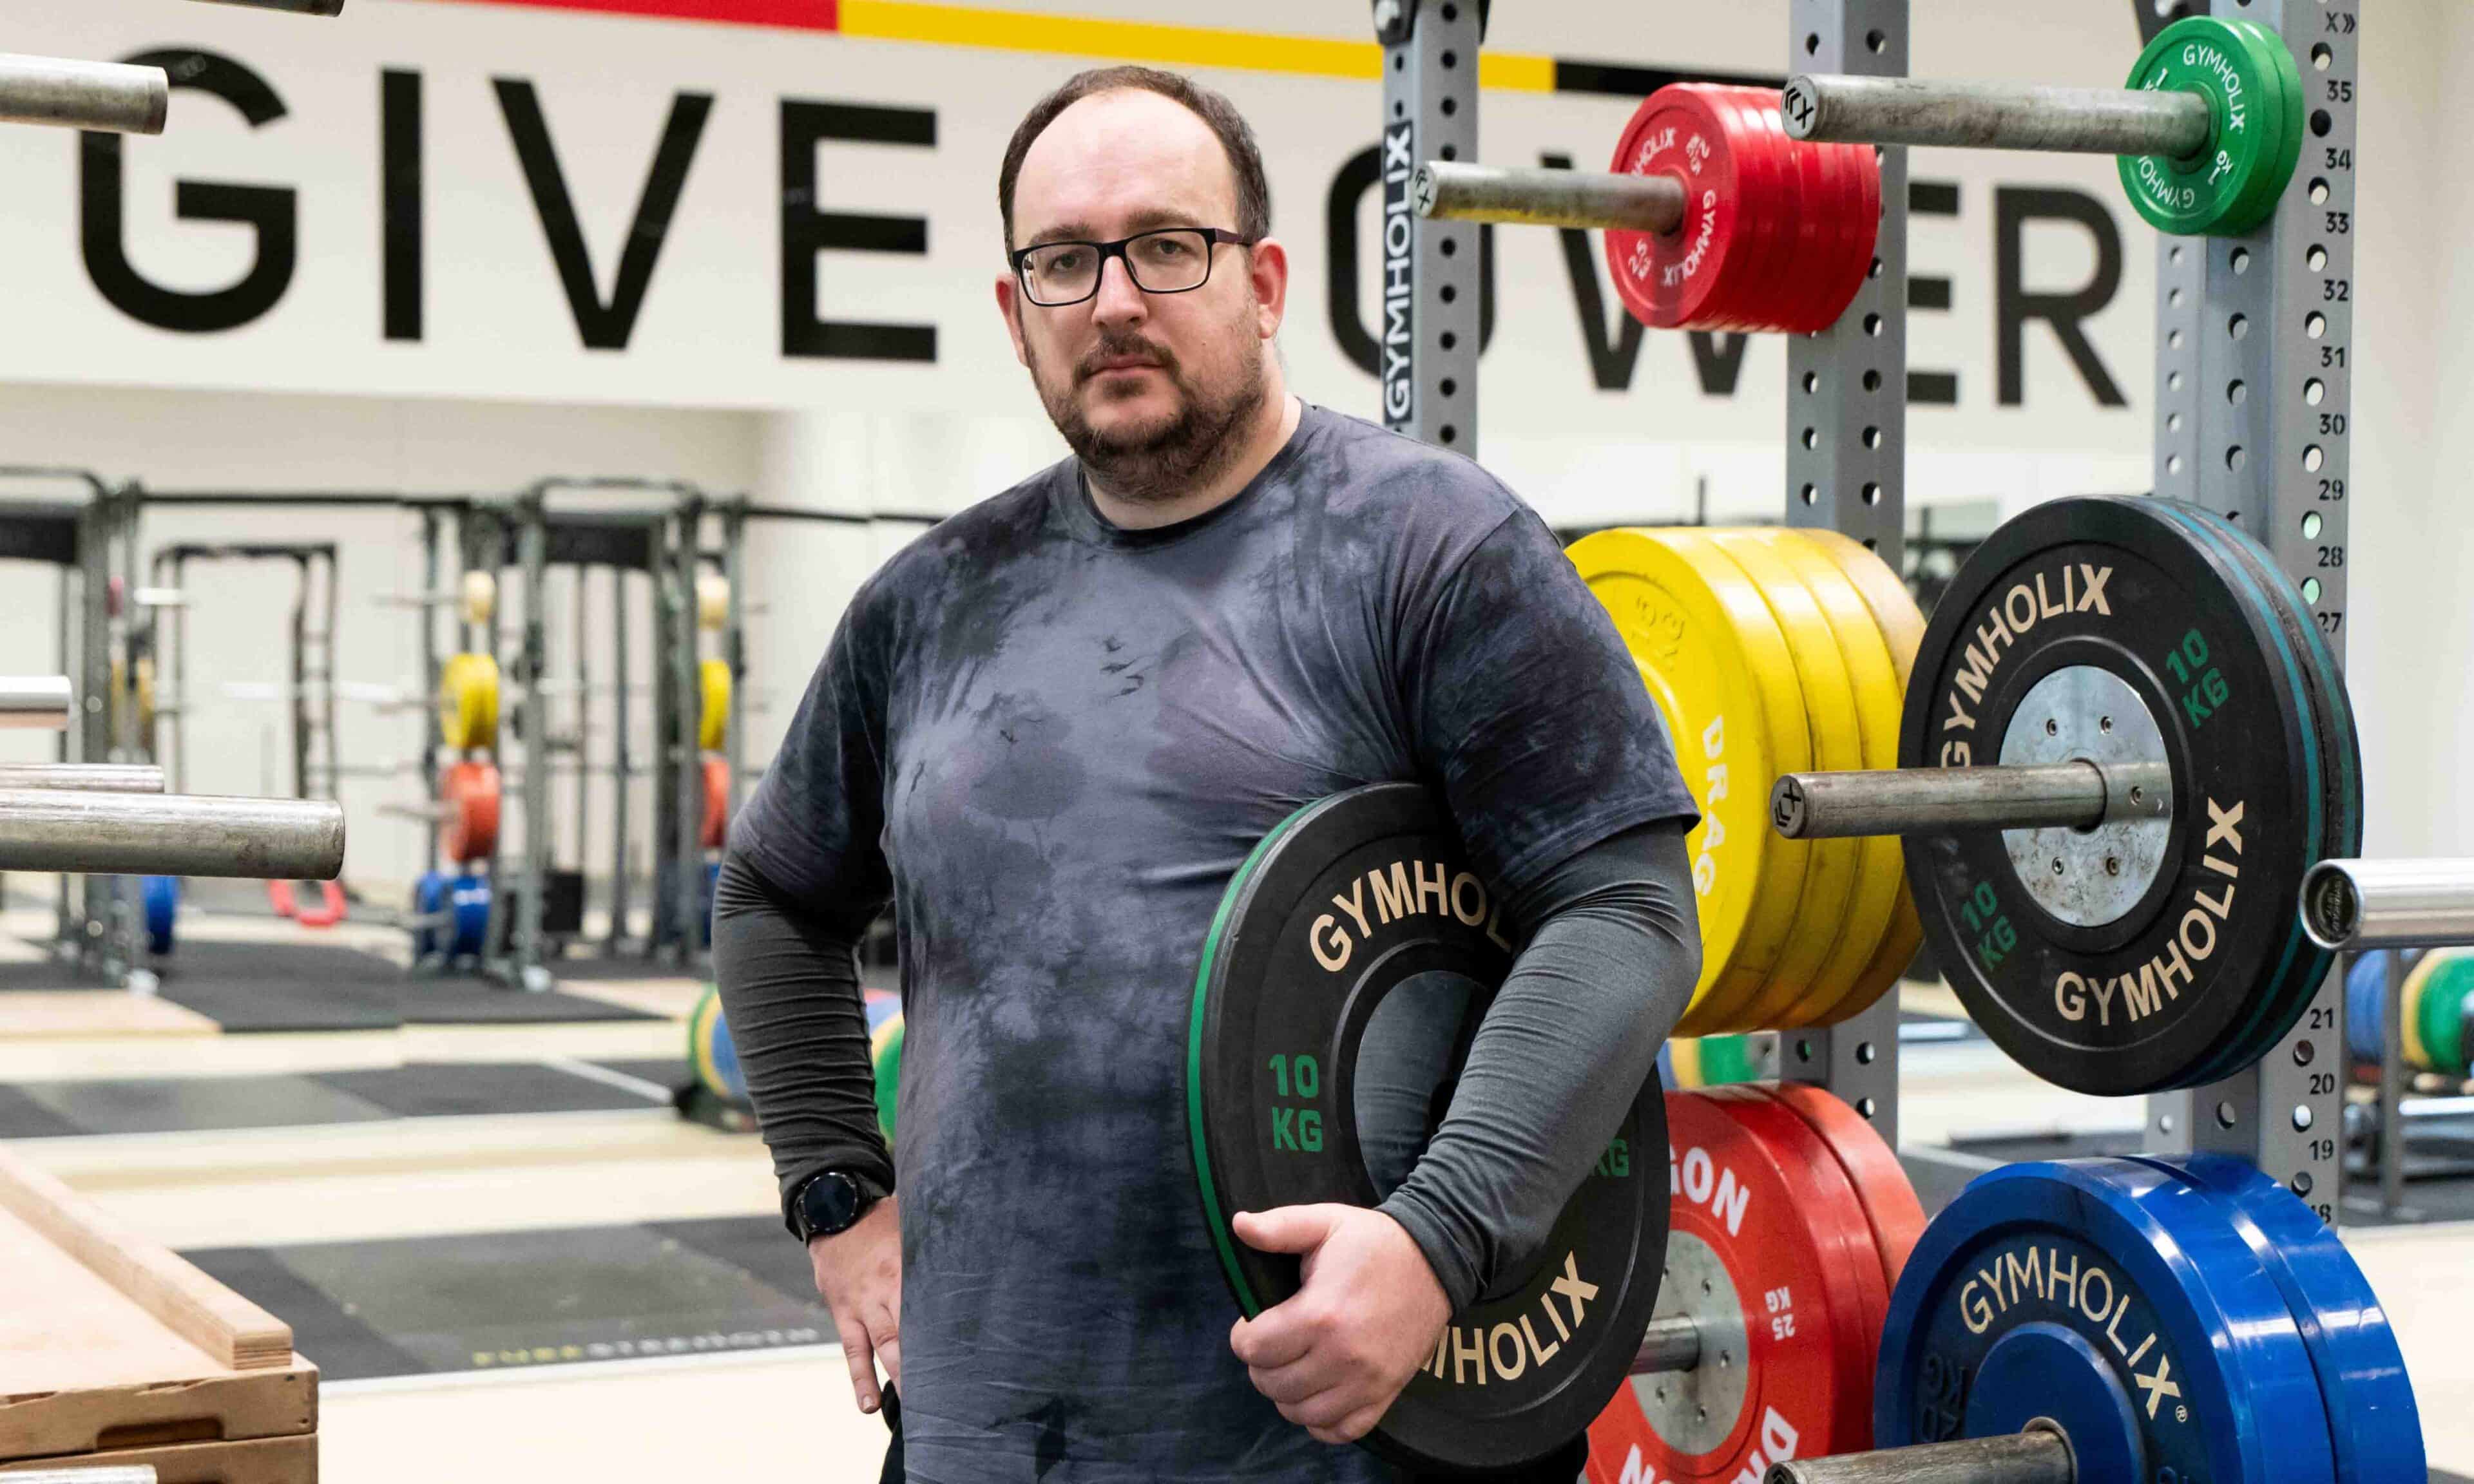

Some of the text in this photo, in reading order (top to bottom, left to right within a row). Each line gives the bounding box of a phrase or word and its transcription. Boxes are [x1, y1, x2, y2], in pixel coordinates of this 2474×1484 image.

[2183, 44, 2246, 131] GYMHOLIX
[2327, 80, 2352, 102] 35
[2325, 147, 2351, 171] 34
[80, 45, 938, 363] GIVE
[2138, 155, 2194, 209] GYMHO
[2326, 211, 2349, 234] 33
[1386, 126, 1411, 419] GYMHOLIX
[2324, 280, 2348, 301] 32
[2321, 347, 2345, 368] 31
[2319, 414, 2346, 435] 30
[2319, 479, 2344, 500] 29
[2317, 546, 2343, 567] 28
[1941, 564, 2113, 768] GYMHOLIX
[2166, 627, 2210, 685] 10
[2182, 667, 2229, 728] KG
[1694, 714, 1729, 896] DRAG
[1310, 859, 1511, 973] GYMHOL
[1961, 880, 1998, 934] 10
[2055, 796, 2244, 1026] GYMHOLIX
[1978, 915, 2018, 969] KG
[2310, 1009, 2335, 1030] 21
[1269, 1053, 1319, 1098] 10
[2309, 1073, 2335, 1095] 20
[1272, 1106, 1323, 1152] KG
[2308, 1139, 2334, 1161] 19
[1764, 1286, 1792, 1313] KG
[1772, 1313, 1796, 1342] 25
